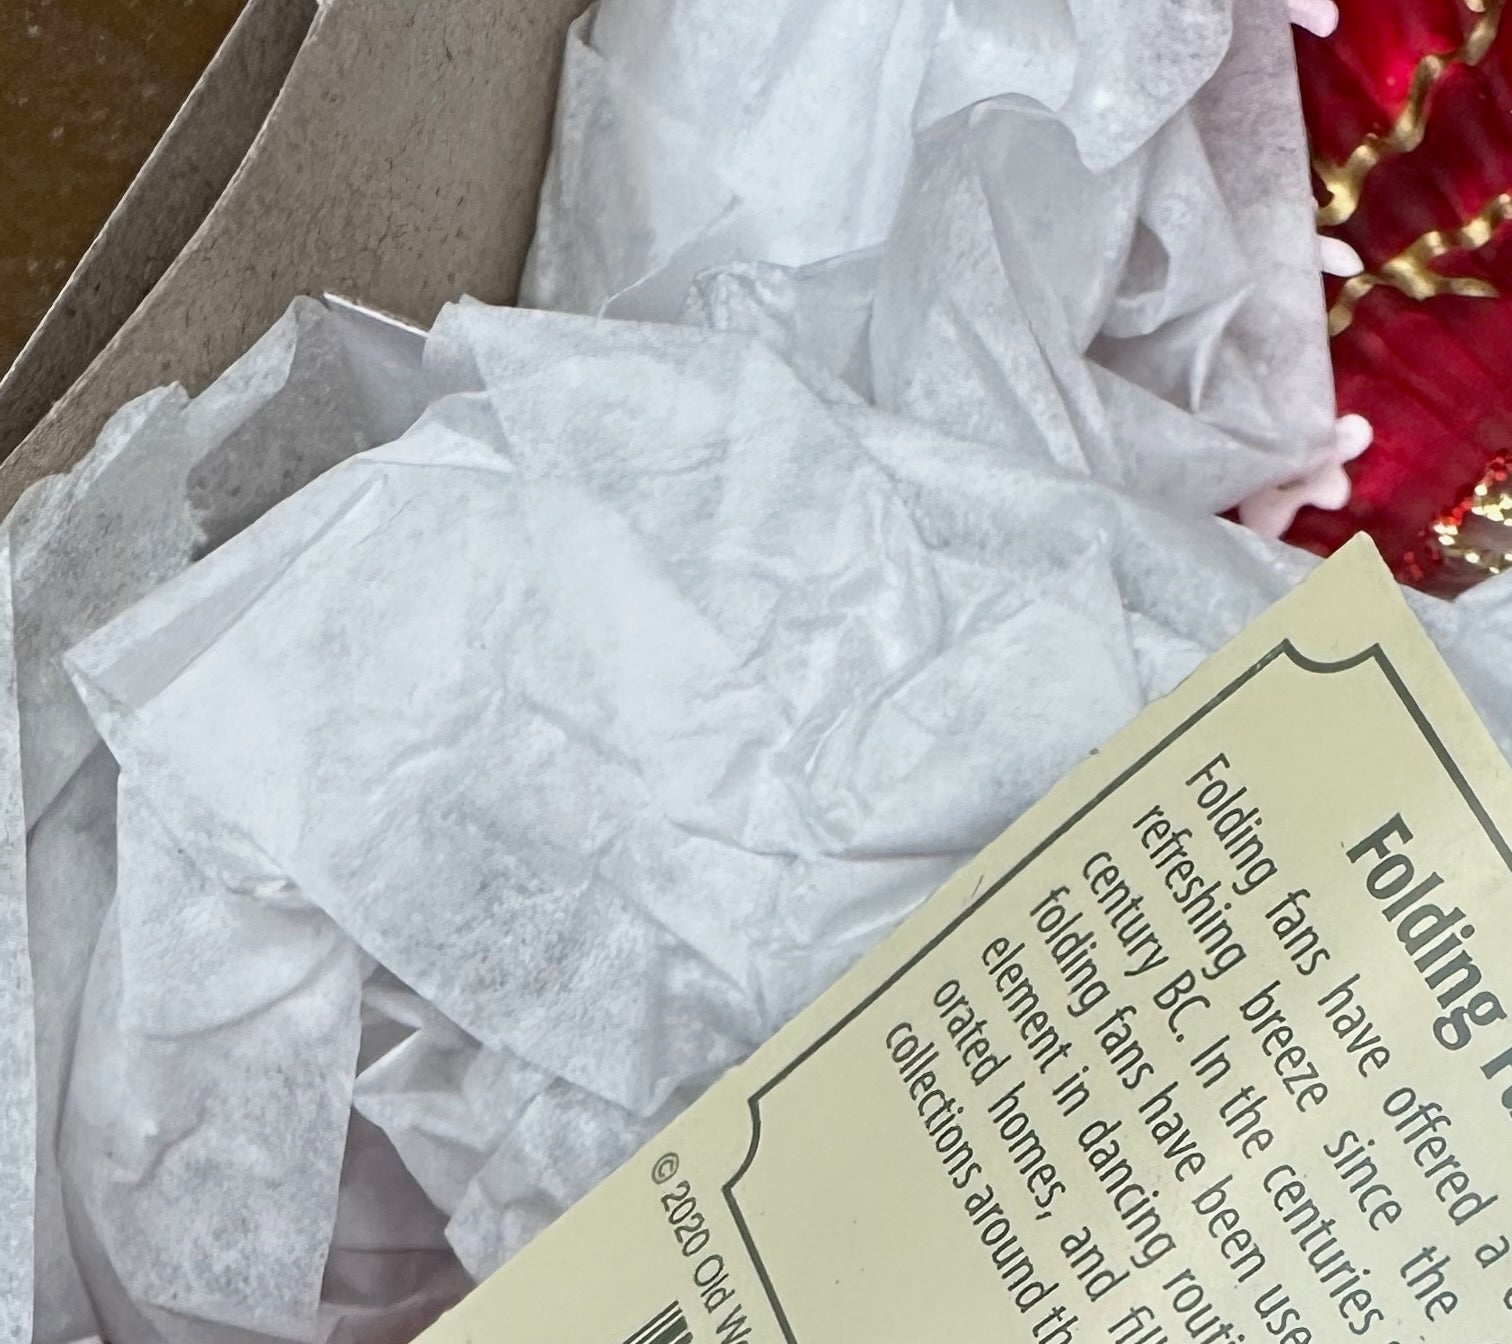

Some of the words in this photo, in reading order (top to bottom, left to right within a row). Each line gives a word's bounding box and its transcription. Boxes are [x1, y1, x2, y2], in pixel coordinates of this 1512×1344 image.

[1028, 884, 1112, 1020] folding
[1092, 1004, 1156, 1092] fans
[1137, 1079, 1207, 1184] have
[1189, 1172, 1267, 1285] been
[1081, 850, 1171, 978] century
[1151, 967, 1212, 1044] BC.
[1188, 1033, 1233, 1091] In
[1218, 1084, 1275, 1161] the
[1261, 1163, 1386, 1337] centuries
[1131, 803, 1249, 982] refreshing
[1237, 978, 1330, 1114] breeze
[1322, 1128, 1404, 1233] since
[1398, 1244, 1460, 1324] the
[1184, 751, 1279, 897] Folding
[1263, 887, 1332, 978] fans
[1316, 972, 1392, 1080] have
[1381, 1085, 1500, 1228] offered
[1473, 1234, 1511, 1271] a
[1344, 811, 1509, 1052] Folding
[659, 1179, 711, 1259] 2020
[692, 1253, 737, 1315] Old
[884, 1020, 984, 1190] collections
[963, 1183, 1061, 1315] around
[932, 978, 1014, 1088] orated
[986, 1079, 1068, 1222] homes,
[1058, 1225, 1132, 1304] and
[980, 936, 1074, 1076] element
[1050, 1064, 1091, 1119] in
[1076, 1118, 1178, 1270] dancing
